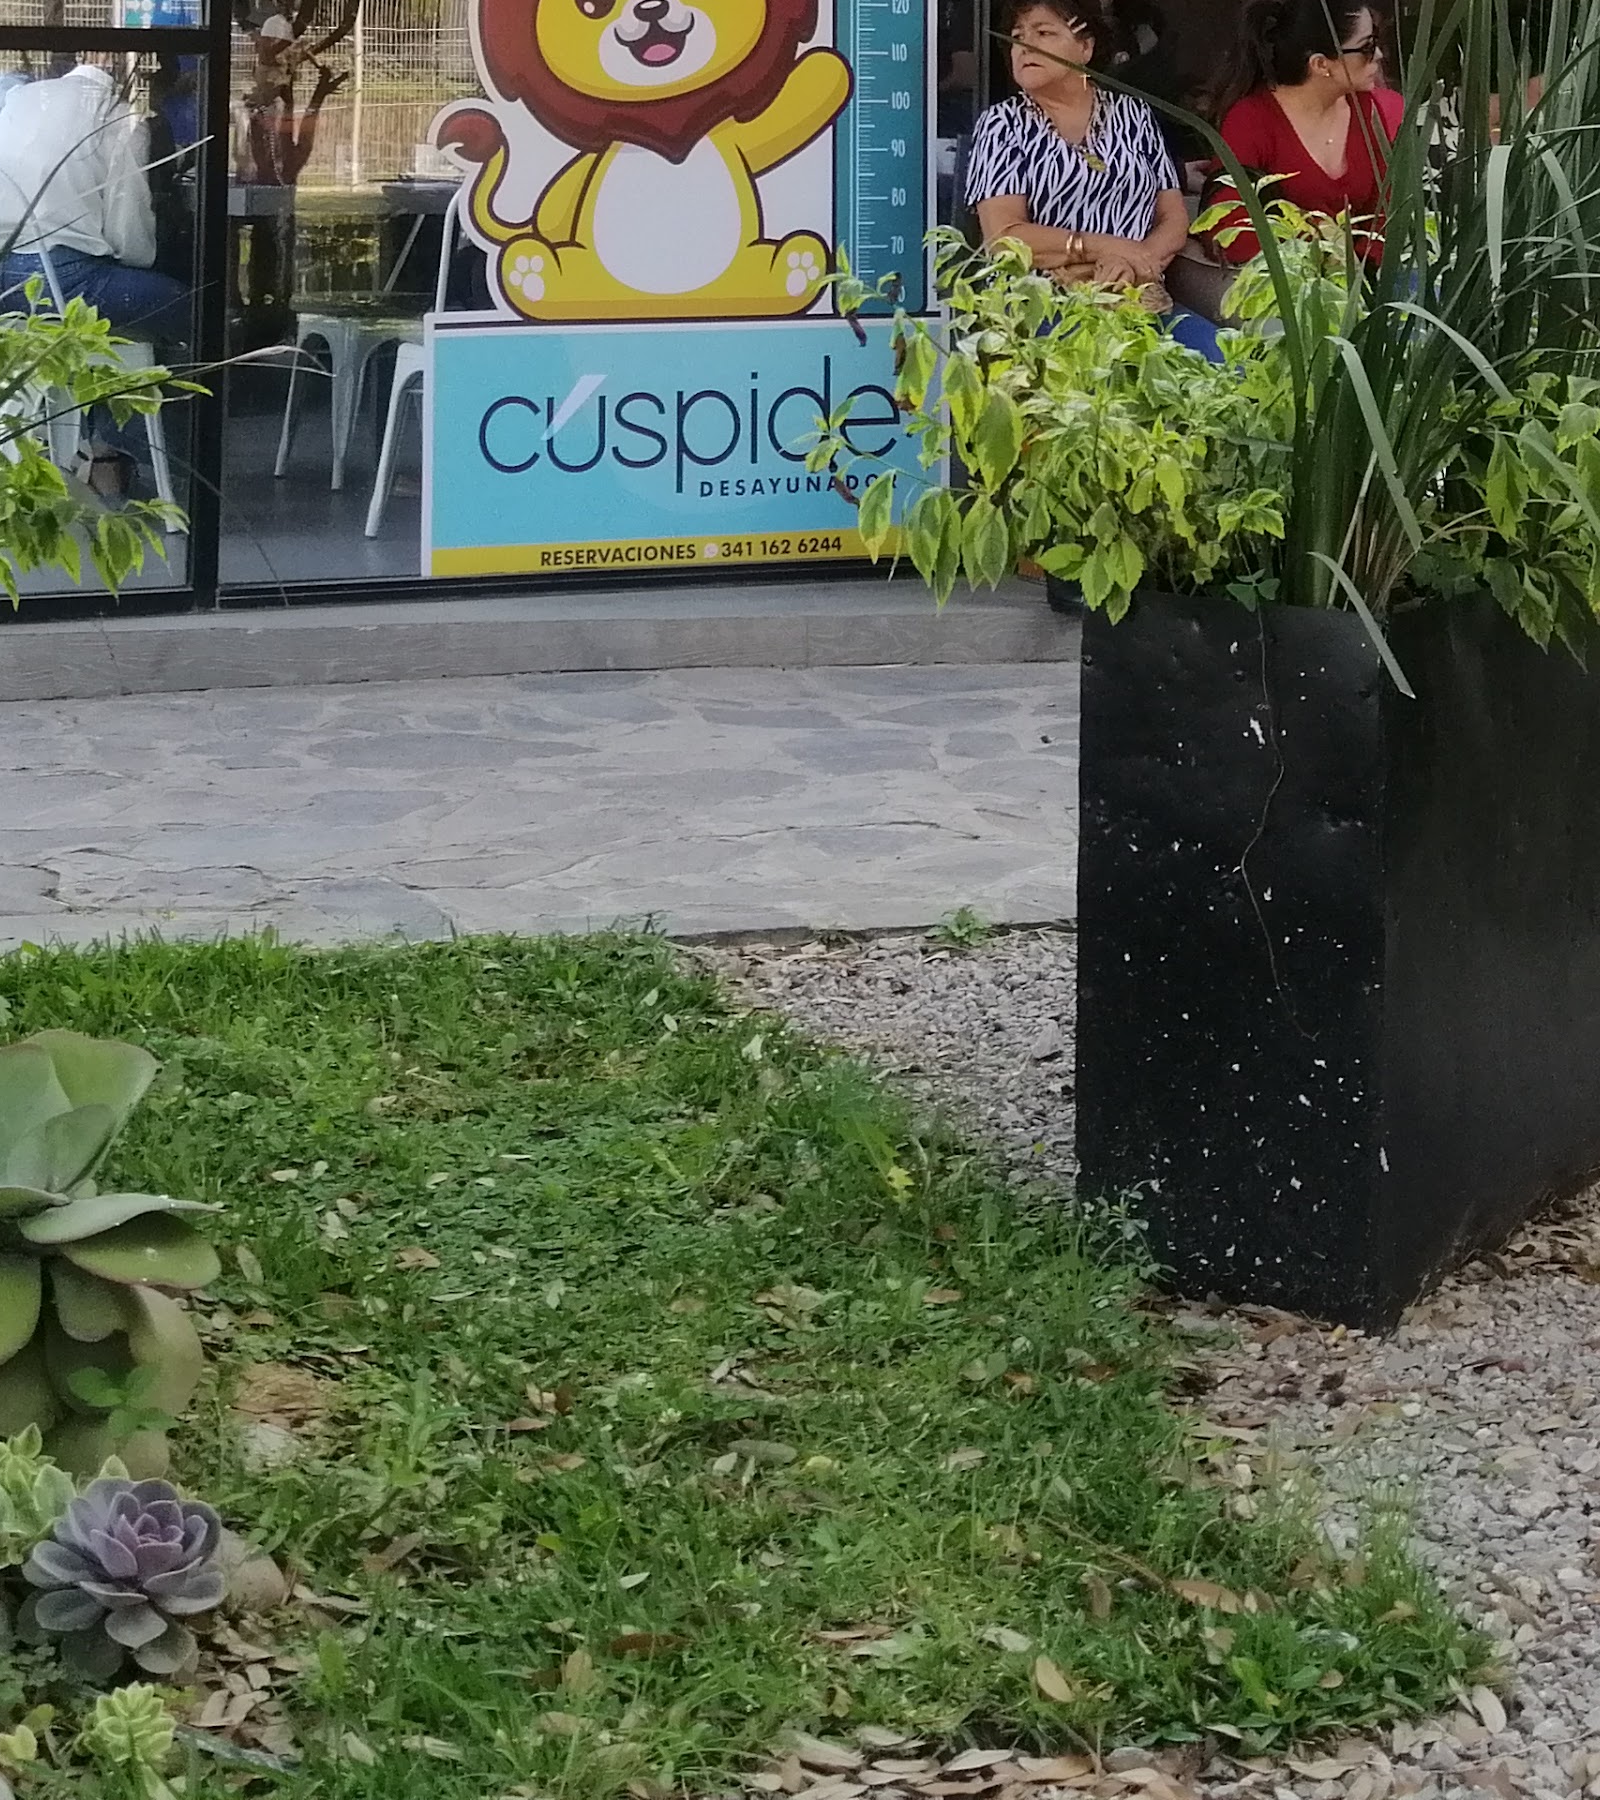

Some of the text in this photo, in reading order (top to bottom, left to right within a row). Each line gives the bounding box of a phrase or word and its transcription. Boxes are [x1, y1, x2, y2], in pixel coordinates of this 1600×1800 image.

[891, 43, 907, 62] 110
[891, 91, 911, 110] 100
[890, 139, 906, 158] 90
[891, 188, 906, 206] 80
[890, 236, 904, 255] 70
[479, 354, 901, 494] cúspide
[540, 536, 842, 567] RESERVACIONES 341 162 6244
